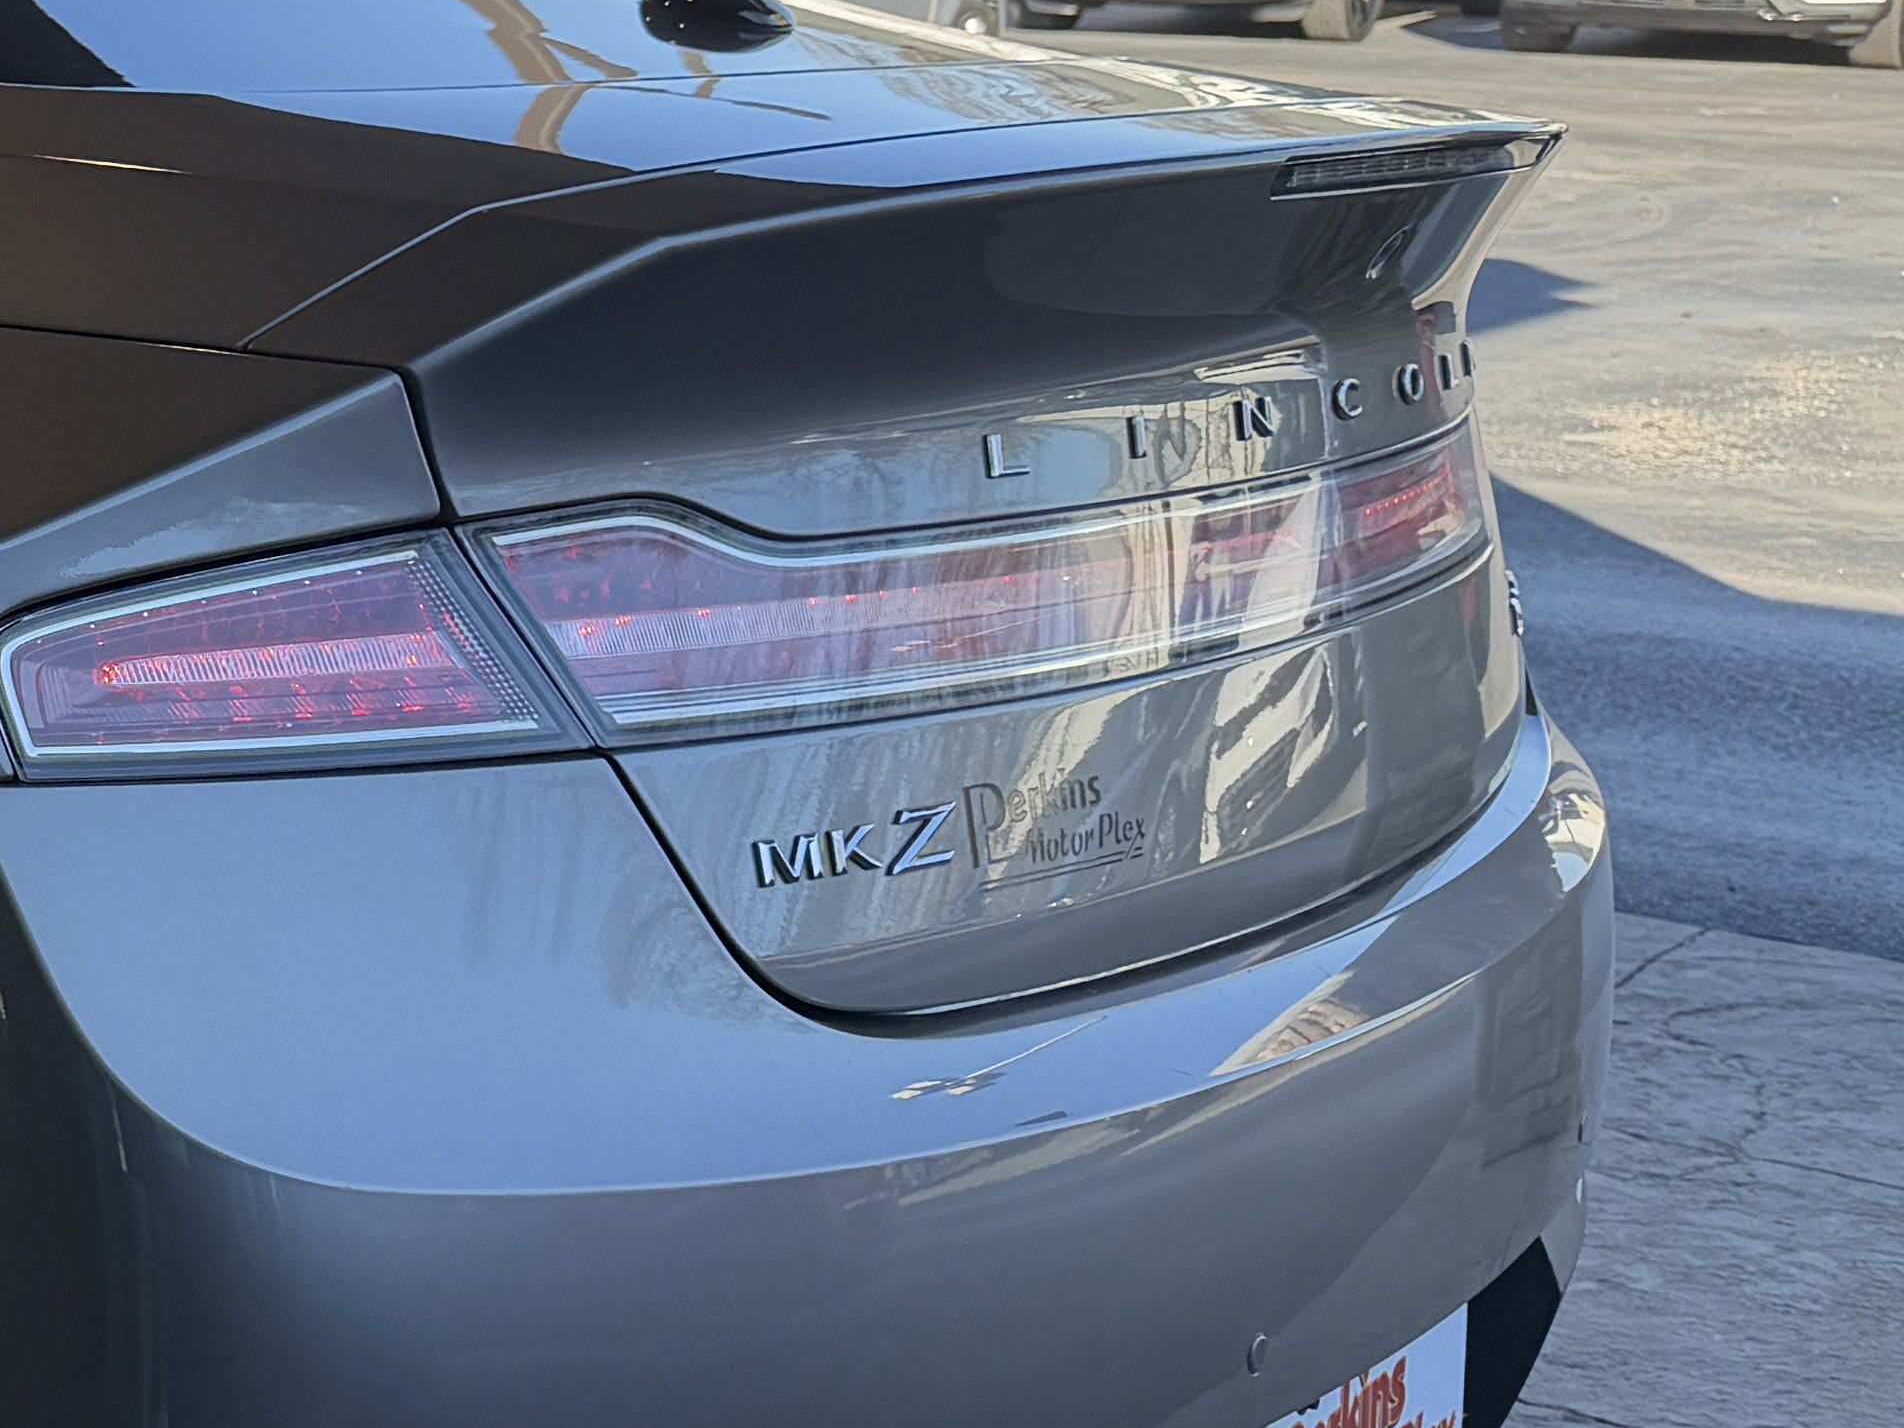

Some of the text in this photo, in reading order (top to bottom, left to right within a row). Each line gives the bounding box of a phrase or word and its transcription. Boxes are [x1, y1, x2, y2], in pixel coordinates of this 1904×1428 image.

[751, 800, 956, 888] MKZ
[962, 767, 1103, 869] Perkins
[1026, 811, 1147, 865] Motor Plex
